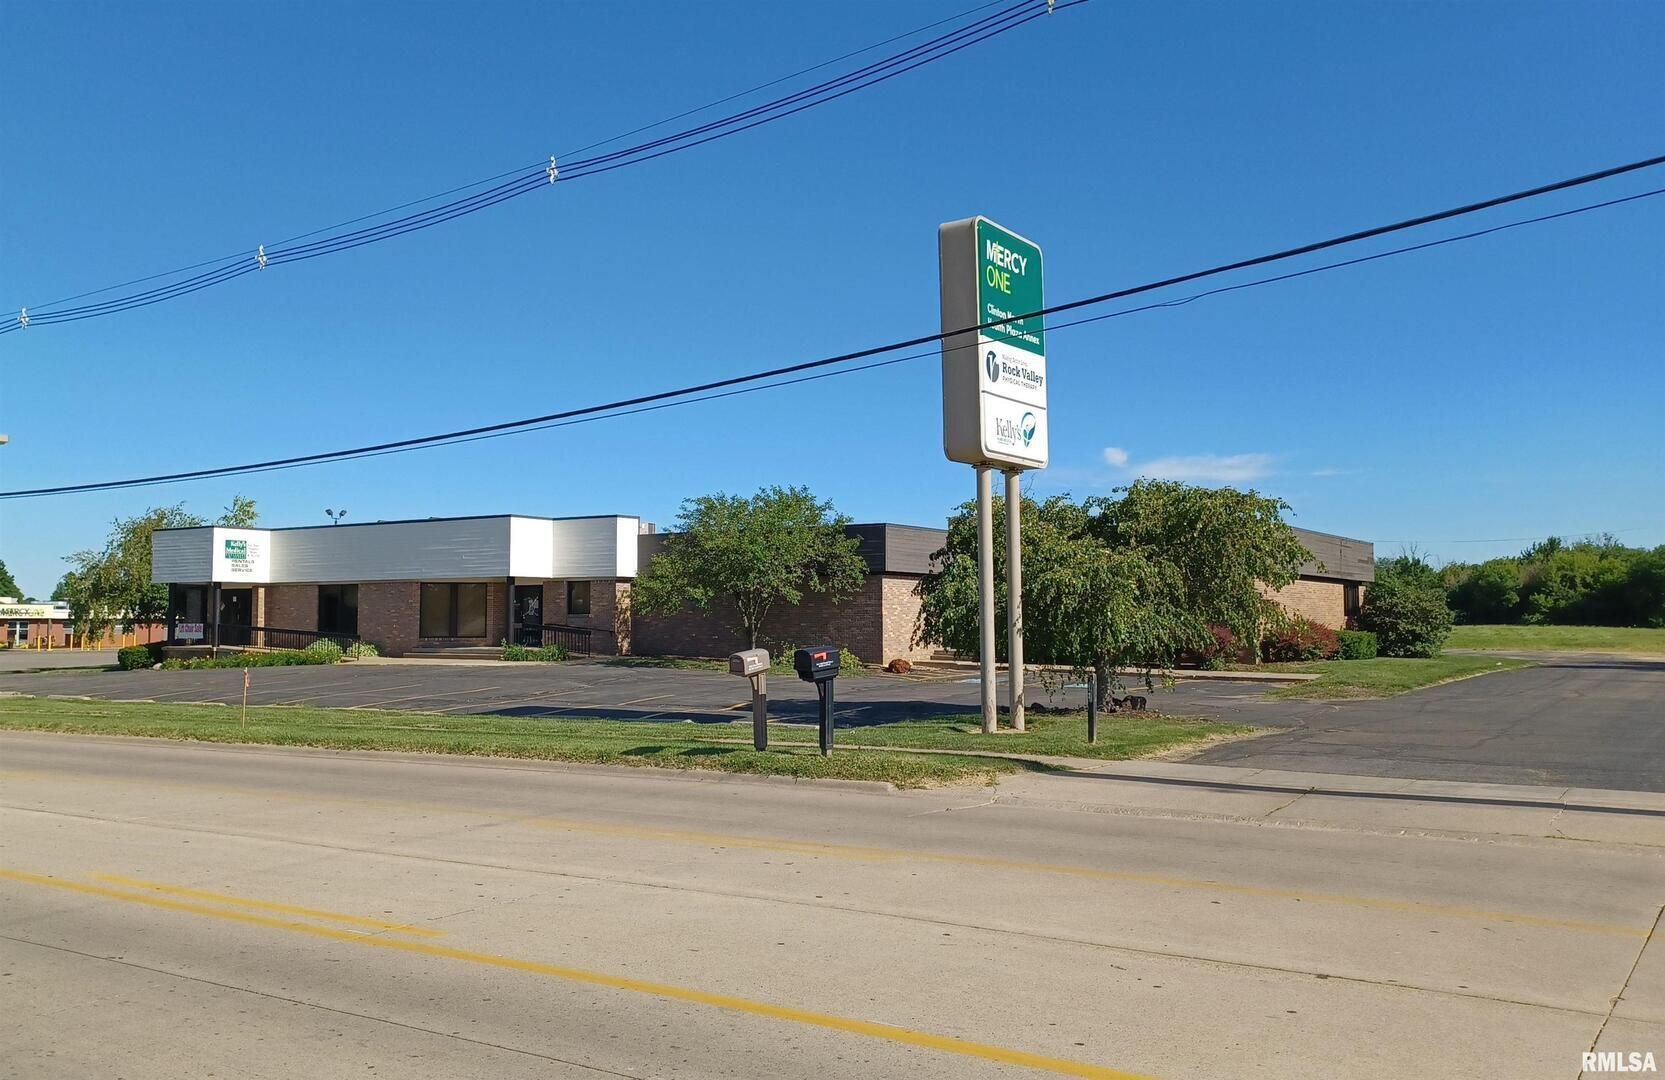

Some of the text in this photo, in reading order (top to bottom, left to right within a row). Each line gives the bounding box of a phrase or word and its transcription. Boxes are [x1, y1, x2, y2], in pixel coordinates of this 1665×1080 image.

[986, 239, 1027, 276] MERCY
[986, 265, 1011, 294] ONE
[987, 303, 1006, 319] Clinton
[1006, 324, 1023, 339] Plaza
[1002, 362, 1044, 387] Rock Valley
[996, 417, 1022, 446] Kelly's
